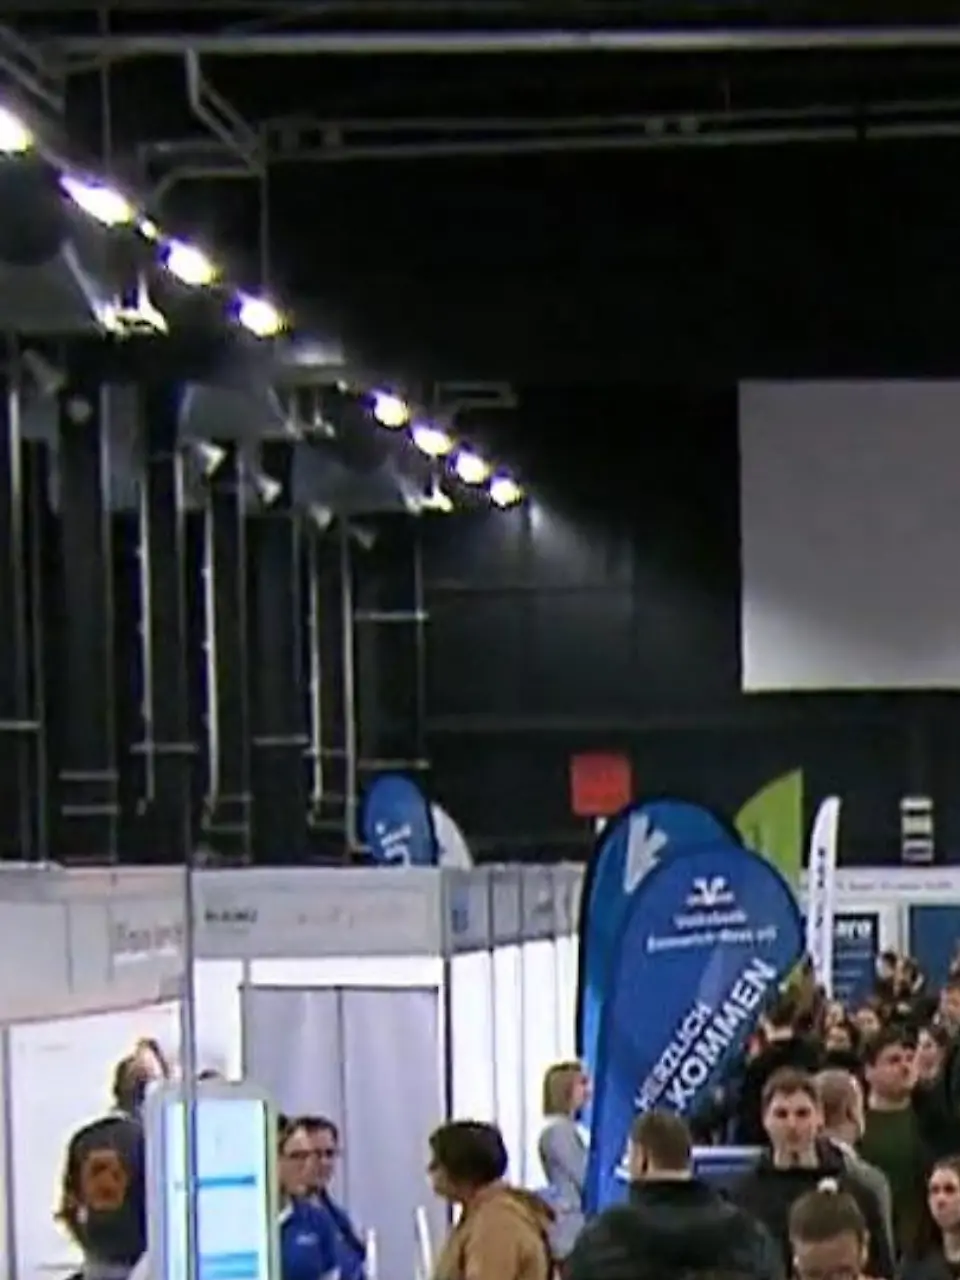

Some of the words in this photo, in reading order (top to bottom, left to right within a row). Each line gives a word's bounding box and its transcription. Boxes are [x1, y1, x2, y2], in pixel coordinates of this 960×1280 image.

[837, 920, 872, 939] aro
[635, 999, 712, 1111] HERZLICH
[665, 957, 778, 1110] KOMMEN
